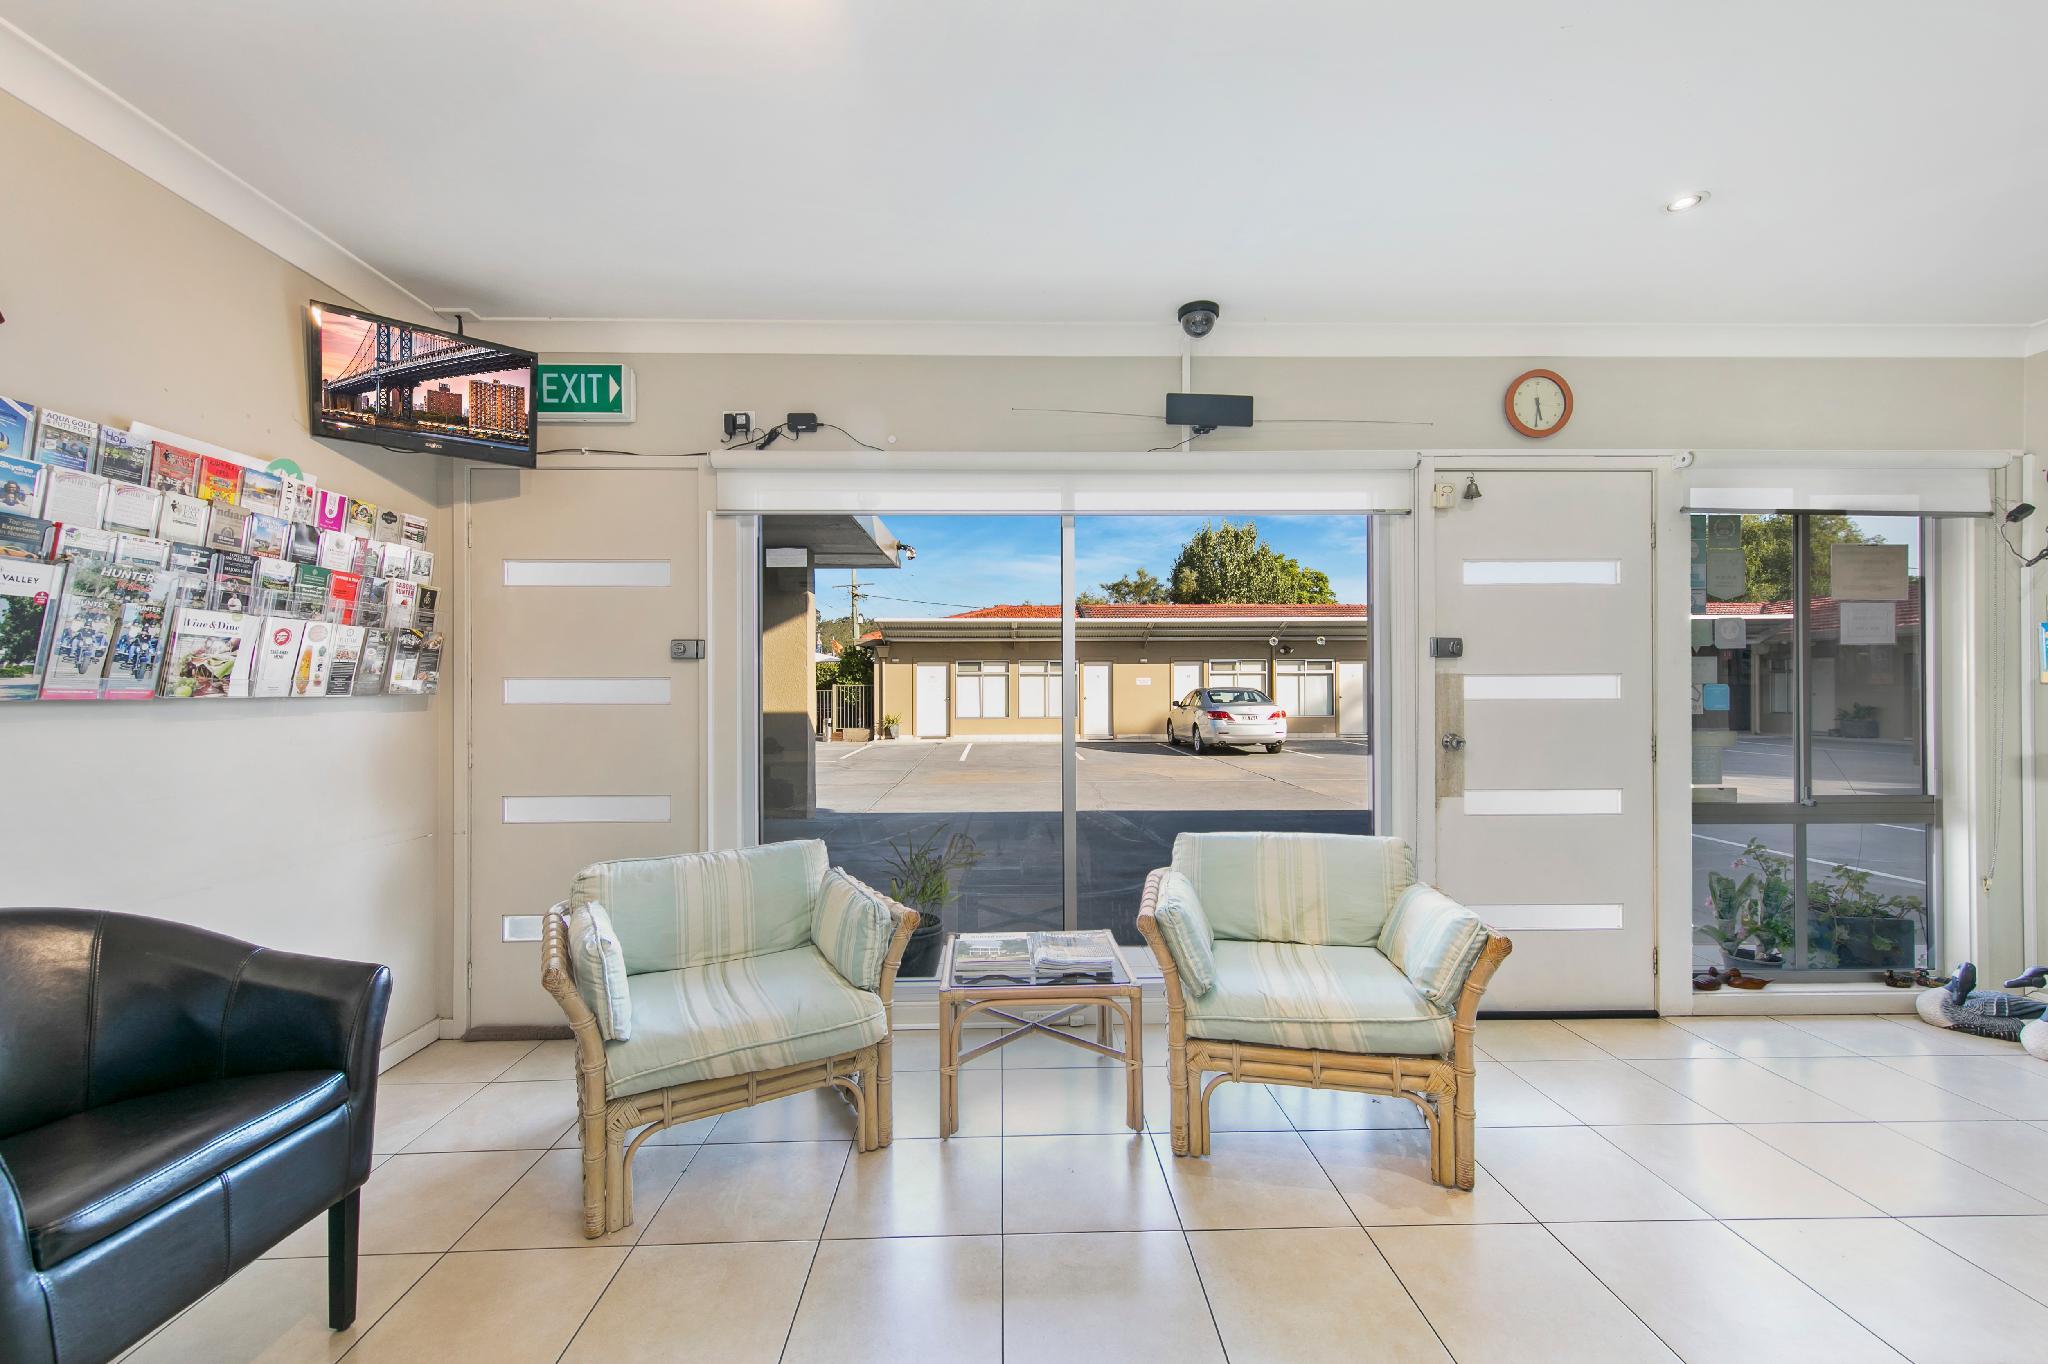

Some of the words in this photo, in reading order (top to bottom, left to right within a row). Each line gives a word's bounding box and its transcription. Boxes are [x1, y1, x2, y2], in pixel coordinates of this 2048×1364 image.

[542, 372, 603, 404] EXIT
[46, 411, 70, 424] AQUA
[71, 418, 92, 430] GOLF
[2, 523, 41, 535] Experience
[2, 573, 40, 585] VALLEY
[101, 566, 155, 583] HUNTER
[134, 604, 162, 613] HUNTER
[183, 617, 207, 628] Wine
[208, 620, 216, 629] &
[217, 620, 240, 631] Dine
